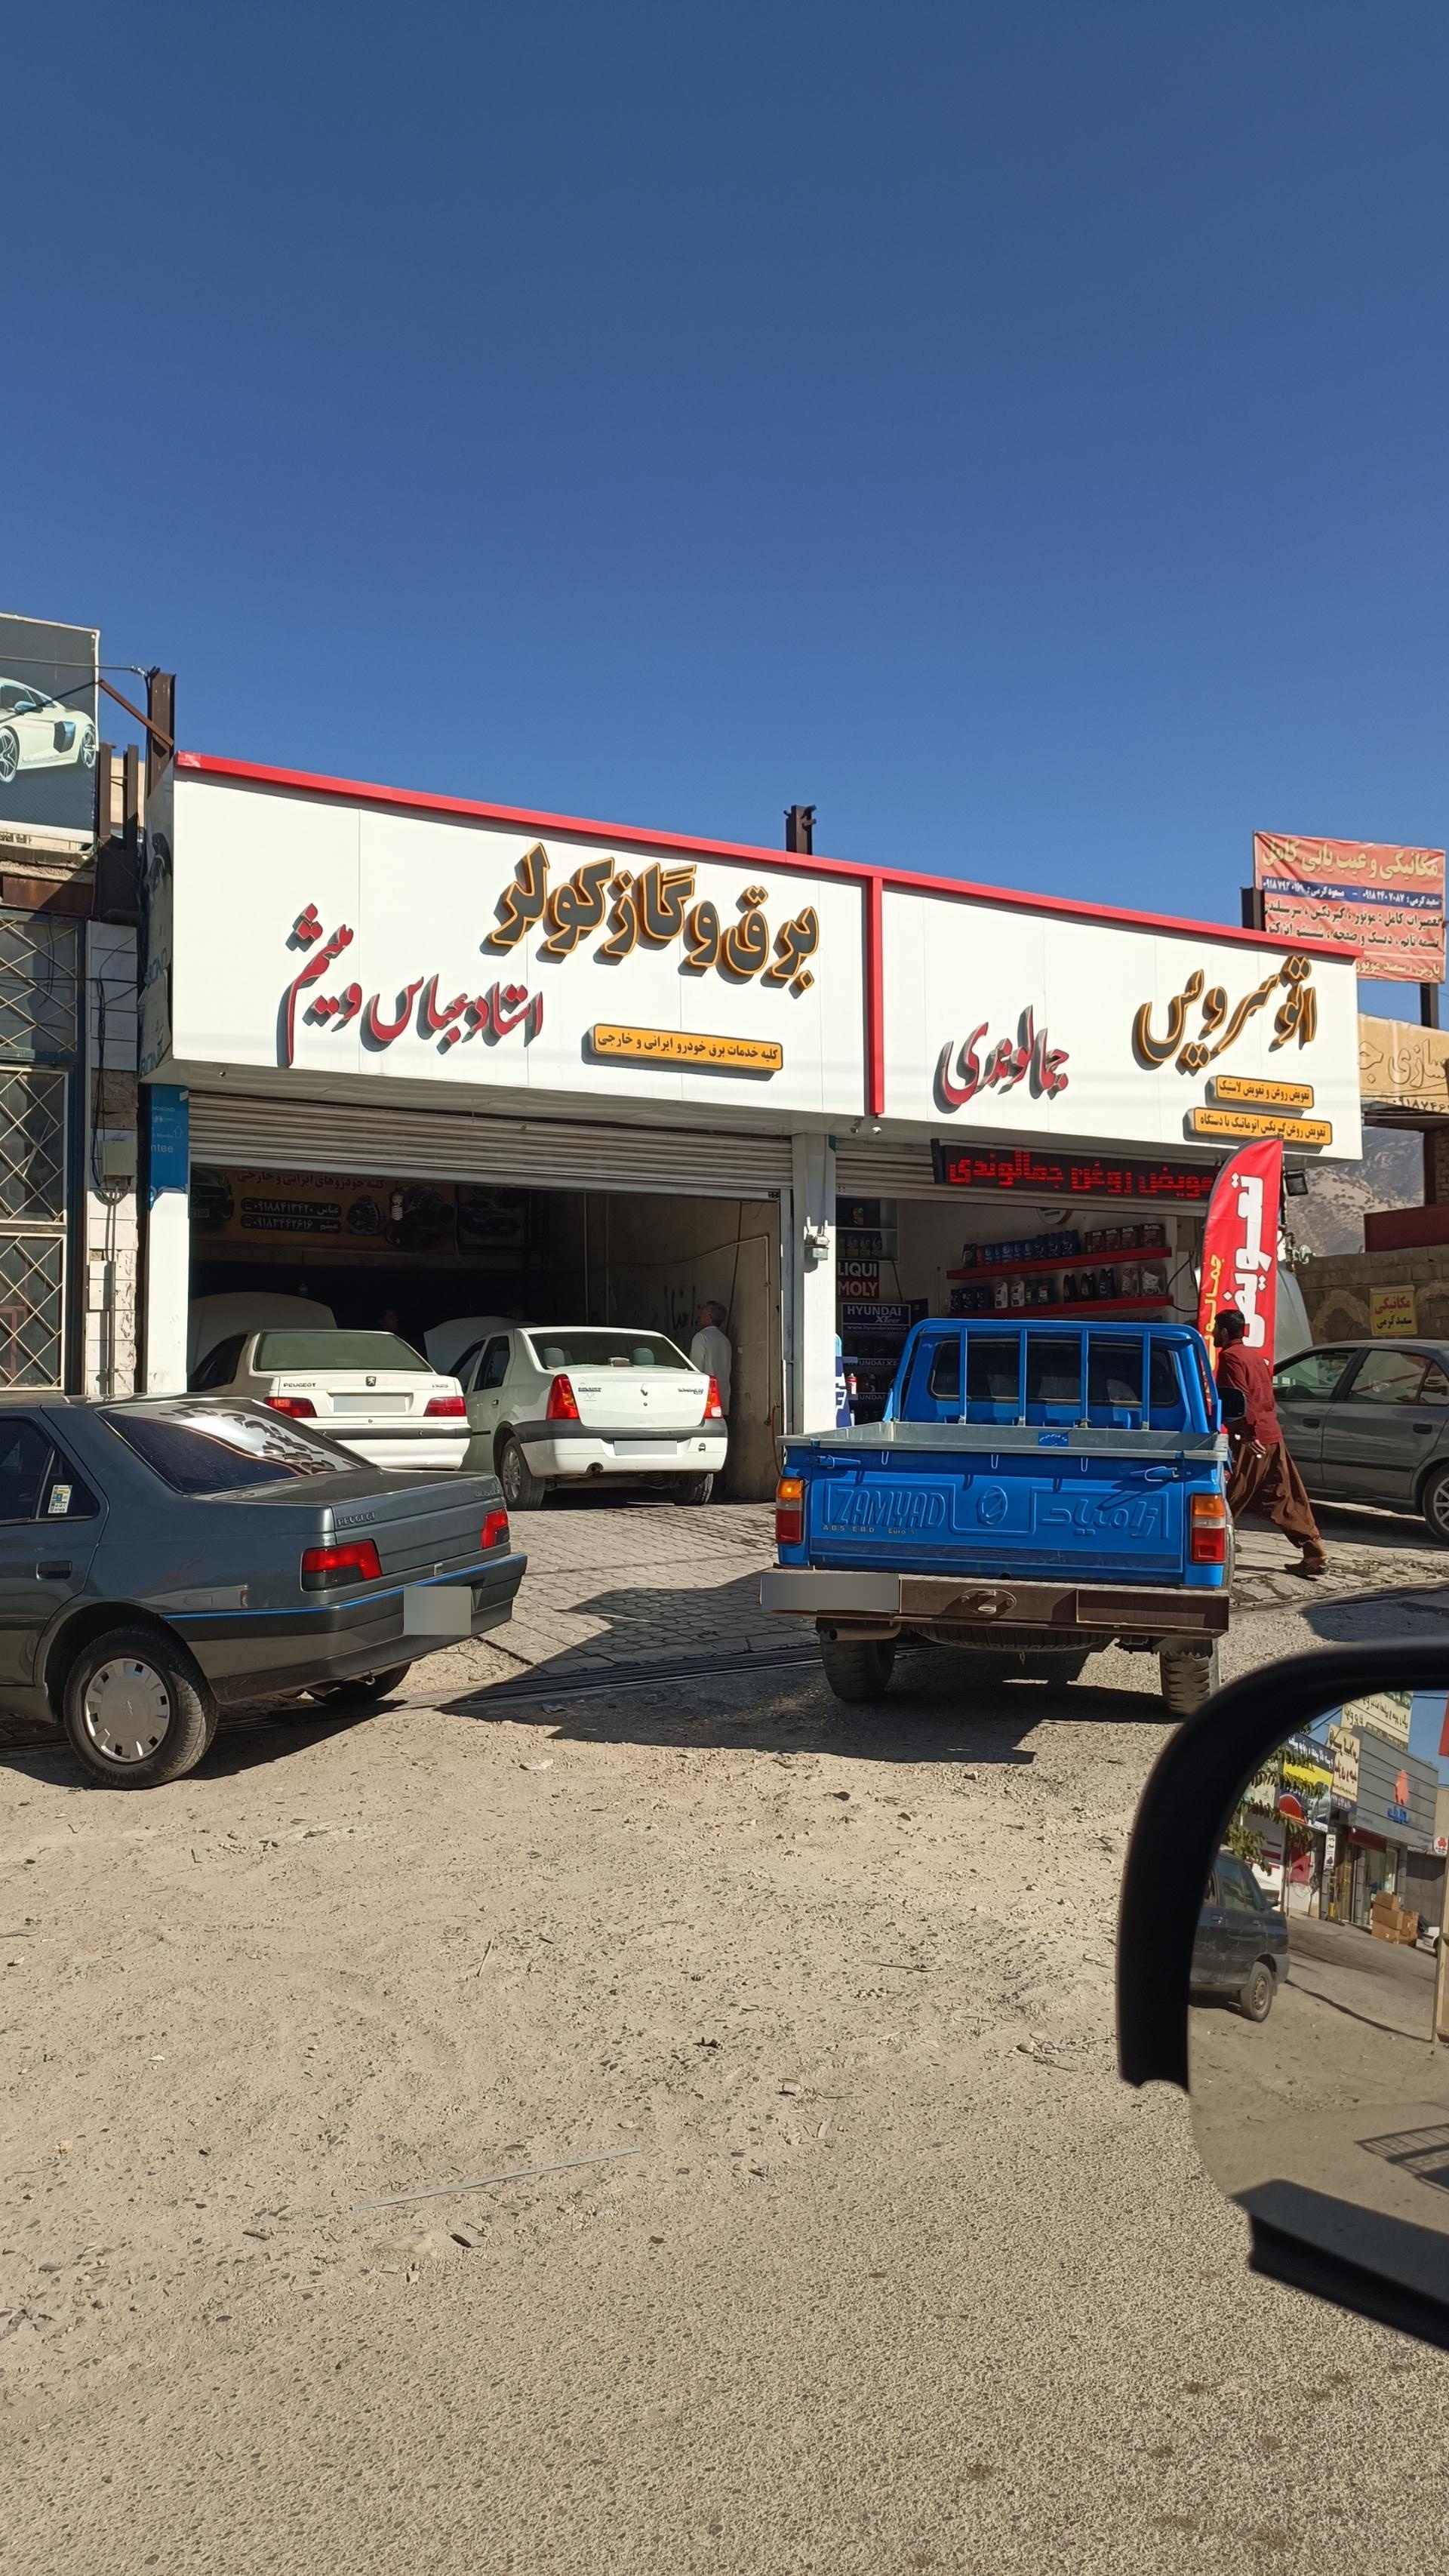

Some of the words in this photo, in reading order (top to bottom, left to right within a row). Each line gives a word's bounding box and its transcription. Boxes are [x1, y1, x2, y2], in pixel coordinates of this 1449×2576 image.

[1262, 838, 1300, 866] کامل
[1302, 842, 1333, 873] یابی
[1337, 852, 1367, 876] عیب
[1369, 858, 1377, 879] و
[1380, 851, 1438, 882] مکانیکی
[487, 842, 615, 956] کولر
[685, 900, 720, 968] و
[721, 885, 819, 992] برق
[1277, 955, 1317, 1045] اتو
[368, 974, 474, 1045] عباس
[471, 981, 543, 1039] استاد
[1137, 969, 1281, 1067] سرویس
[598, 1033, 632, 1046] خارجی
[636, 1039, 641, 1049] و
[644, 1036, 673, 1051] ایرانی
[677, 1041, 706, 1055] خودرو
[709, 1044, 725, 1057] برق
[728, 1045, 758, 1058] خدمات
[761, 1049, 778, 1062] کلیه
[1243, 1082, 1264, 1096] تعویض
[1266, 1091, 1270, 1100] و
[1271, 1088, 1288, 1100] روغن
[1290, 1089, 1309, 1103] تعویض
[1201, 1113, 1223, 1126] دستگاه
[1287, 1123, 1303, 1137] روغن
[1305, 1125, 1326, 1140] تعویض
[237, 1171, 273, 1184] خارجی
[949, 1149, 1064, 1190] جمالوندی
[1071, 1161, 1132, 1194] روغن
[276, 1176, 281, 1185] و
[283, 1174, 313, 1188] ایرانی
[1139, 1167, 1214, 1198] عویض
[1223, 1172, 1272, 1348] تعویض
[837, 1261, 878, 1277] LIQUI
[837, 1280, 878, 1297] MOLY
[847, 1305, 902, 1316] HYUNDAI
[832, 1488, 946, 1528] ZAMYAD
[337, 1511, 376, 1527] PEUGEOT
[1038, 1498, 1158, 1538] زامیاد
[888, 1527, 906, 1535] Euro
